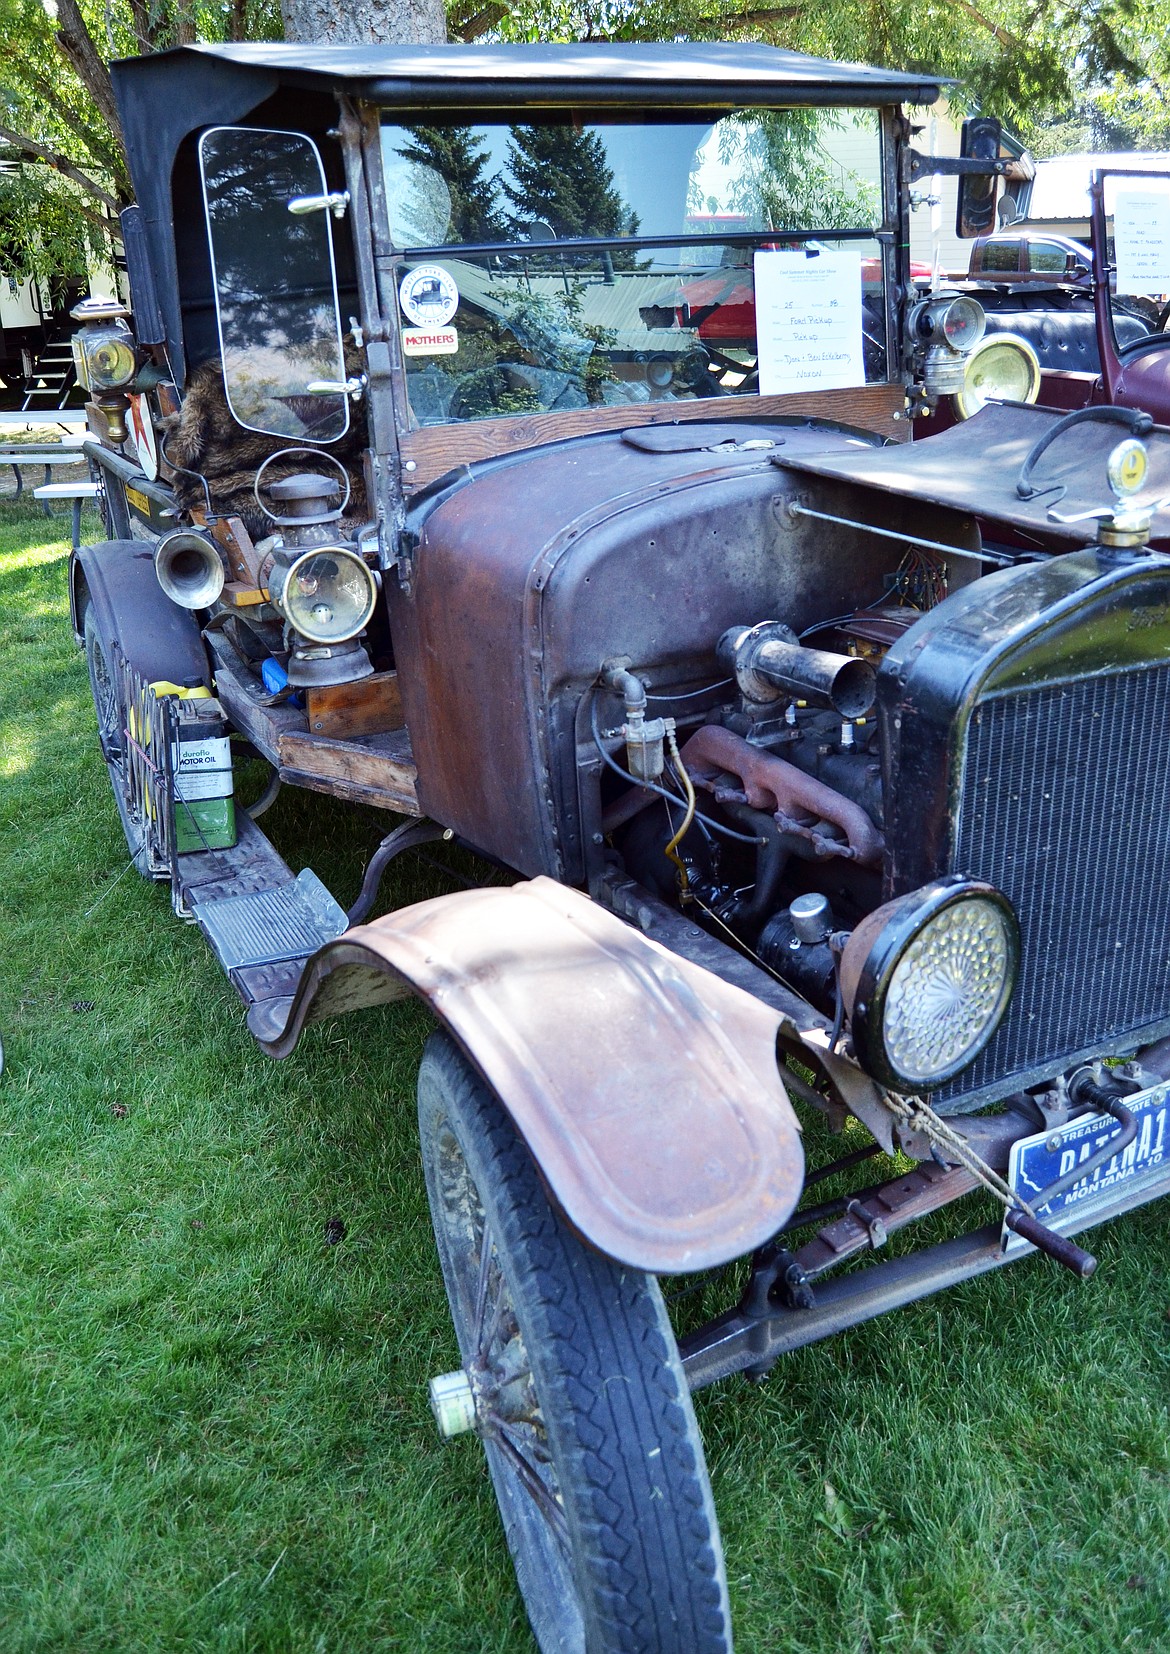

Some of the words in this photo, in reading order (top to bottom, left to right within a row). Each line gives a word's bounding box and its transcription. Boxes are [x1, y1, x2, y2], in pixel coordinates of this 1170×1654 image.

[405, 335, 454, 346] MOTHERS
[183, 750, 210, 758] duroflo
[1129, 1099, 1151, 1113] TATE
[1064, 1165, 1135, 1205] MONTANA
